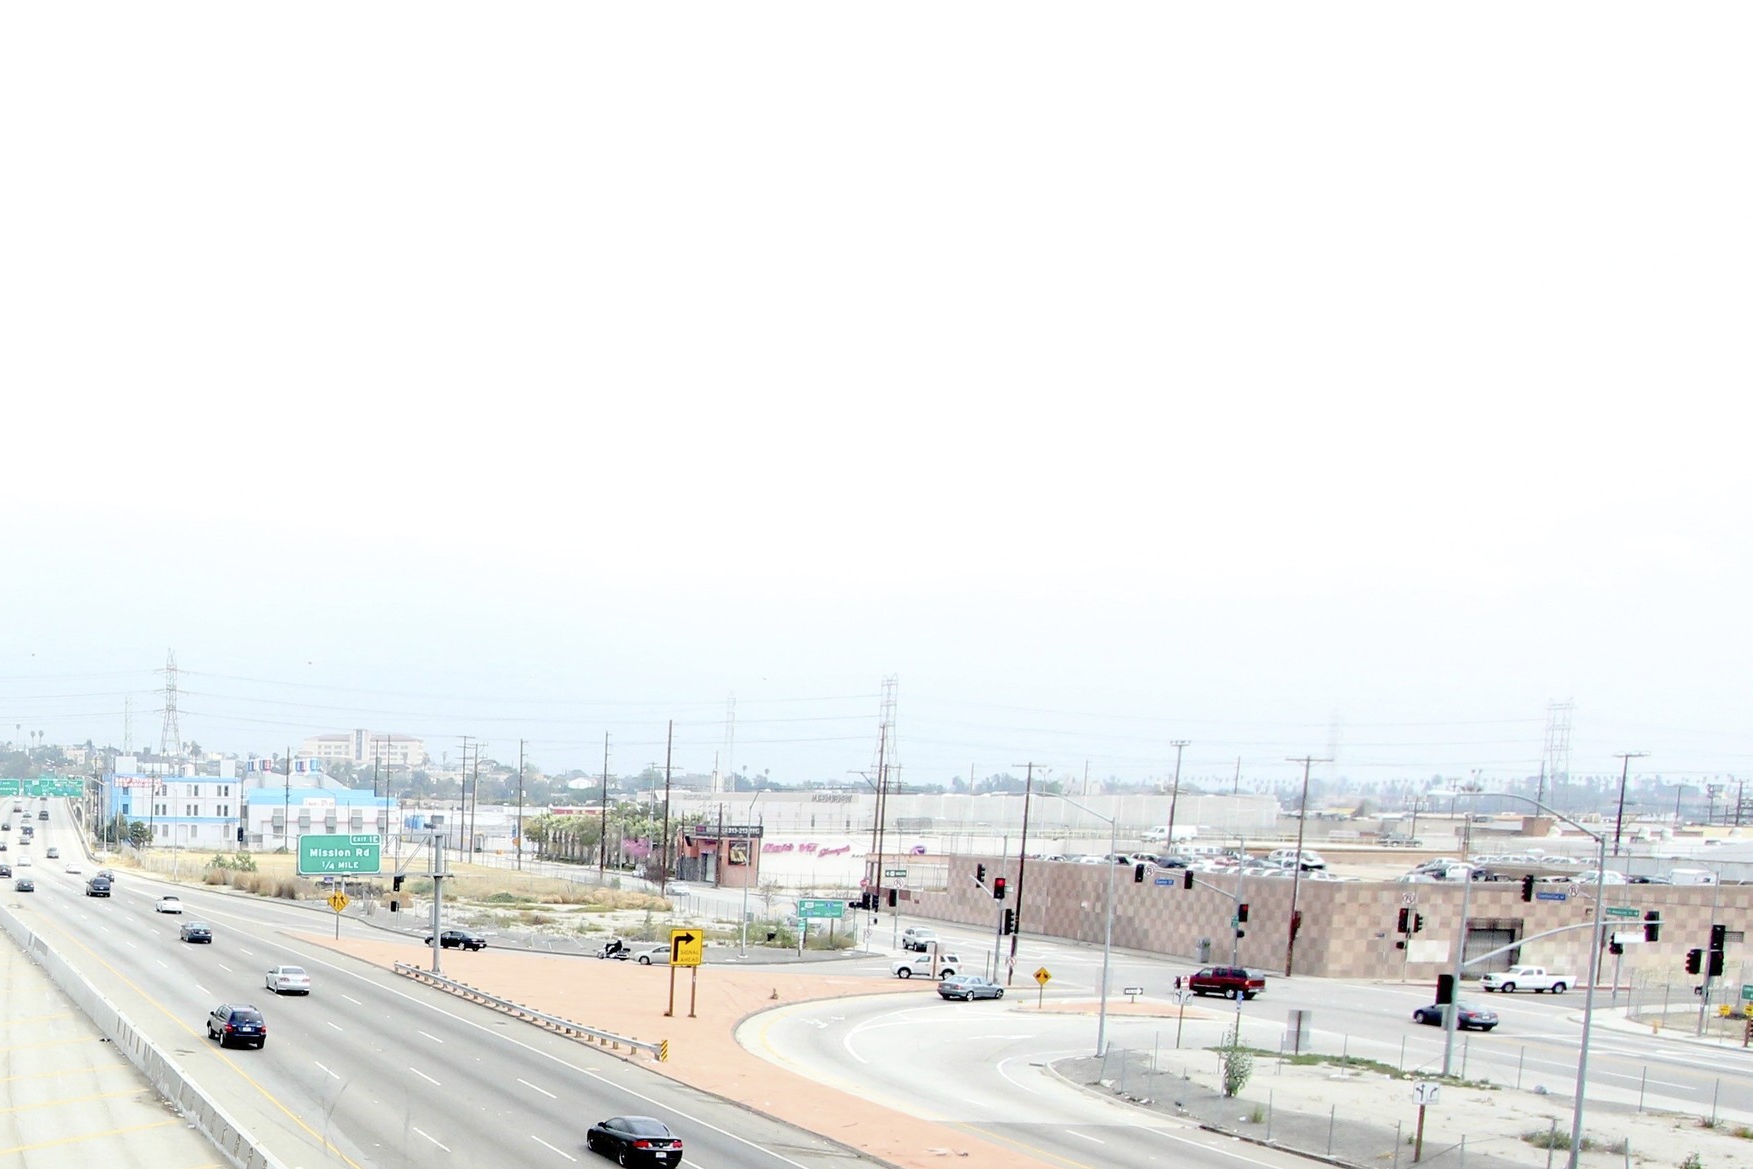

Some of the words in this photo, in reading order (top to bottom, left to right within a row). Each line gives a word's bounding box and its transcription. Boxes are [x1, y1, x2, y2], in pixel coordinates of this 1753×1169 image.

[309, 848, 351, 857] Mission
[355, 848, 370, 857] Rd
[338, 861, 359, 869] MILE
